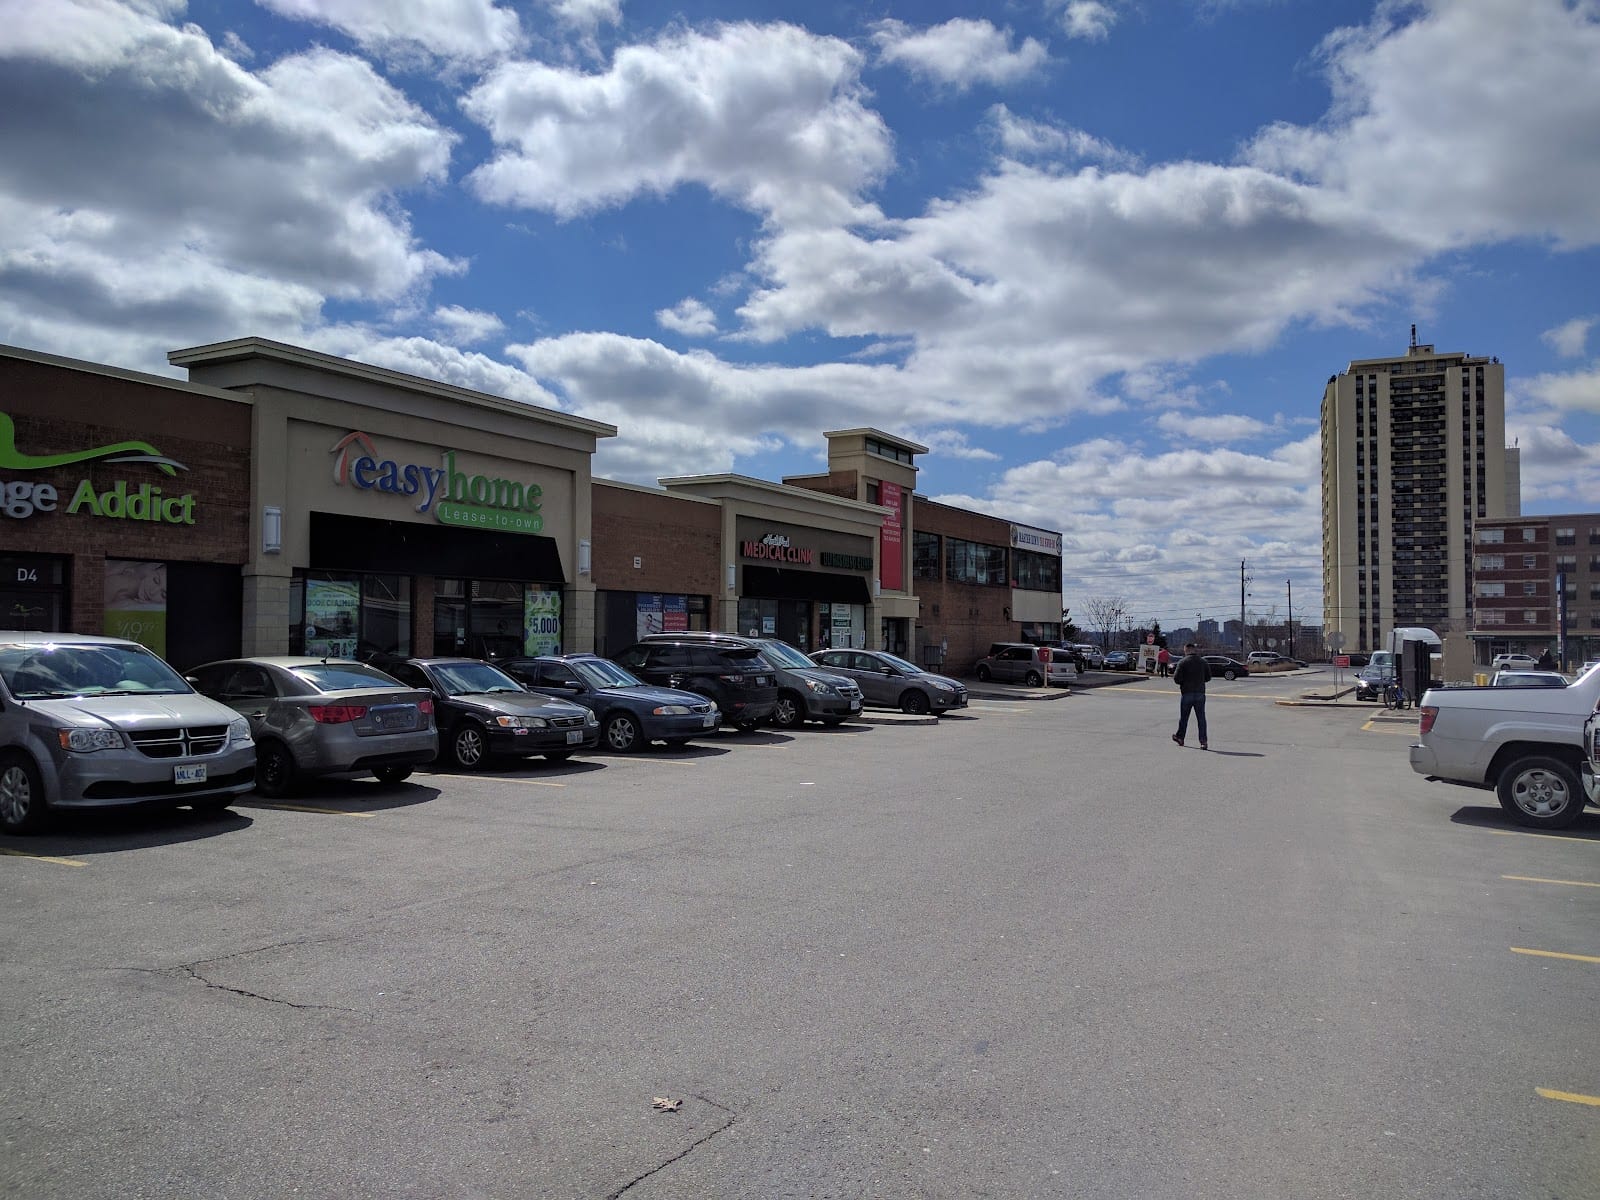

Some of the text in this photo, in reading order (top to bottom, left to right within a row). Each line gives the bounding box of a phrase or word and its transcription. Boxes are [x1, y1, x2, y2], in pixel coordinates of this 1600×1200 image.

[0, 479, 196, 525] ge Addict
[444, 506, 540, 530] Lease-to-own
[743, 541, 787, 561] MEDICAL
[17, 567, 38, 582] D4
